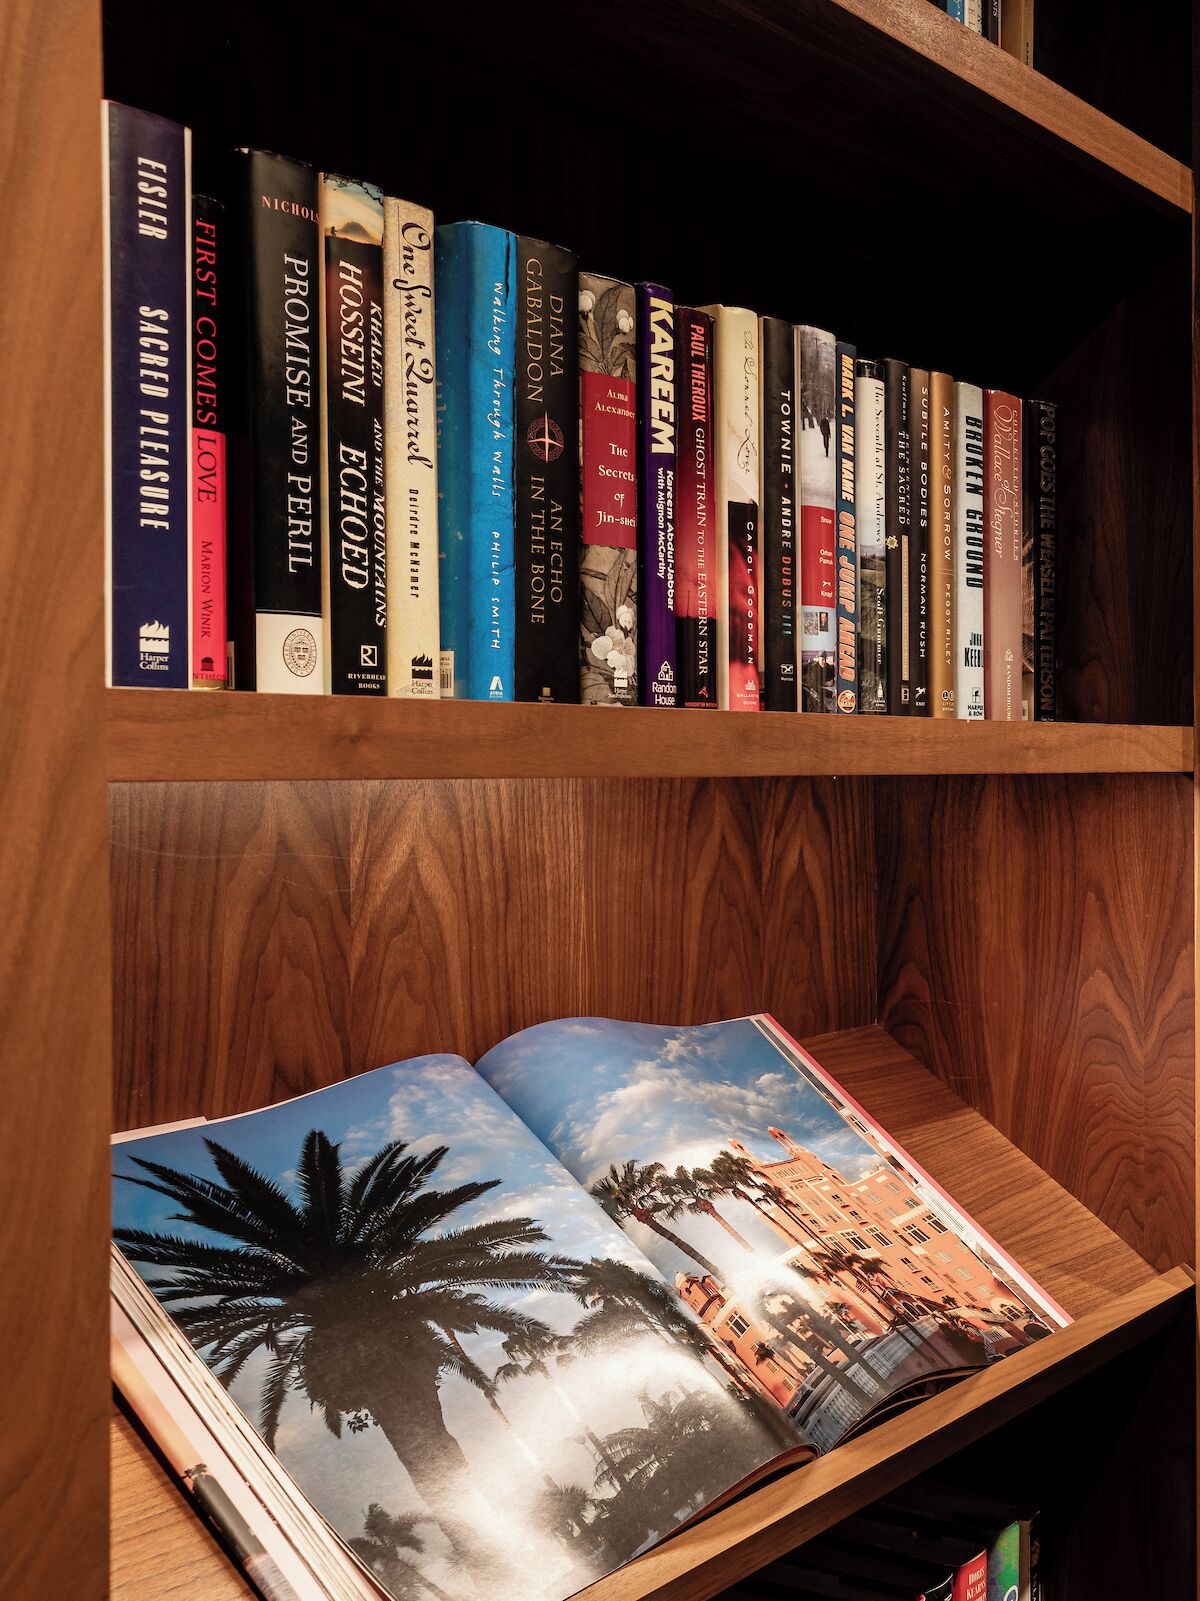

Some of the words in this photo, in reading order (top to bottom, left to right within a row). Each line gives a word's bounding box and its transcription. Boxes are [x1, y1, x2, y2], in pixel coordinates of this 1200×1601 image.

[138, 157, 167, 240] EISLER
[195, 220, 217, 305] FIRST
[401, 222, 432, 275] One
[284, 254, 310, 407] PROMISE
[339, 260, 365, 406] HOSSEINI
[393, 277, 432, 350] Sweet
[526, 258, 544, 403] GABALDON
[550, 294, 564, 377] DIANA
[139, 305, 169, 398] SACRED
[370, 301, 383, 387] KHALED
[691, 324, 705, 357] PAUL
[196, 317, 217, 425] COMES
[651, 296, 675, 454] KAREEM
[692, 361, 707, 422] THEROUX
[841, 353, 854, 402] MARK
[875, 386, 884, 405] The
[372, 418, 382, 451] AND
[403, 353, 434, 470] Quarrel
[780, 390, 791, 474] TOWNIE
[841, 406, 854, 418] L.
[875, 409, 884, 453] Seventh
[920, 387, 928, 451] SUBTLE
[292, 416, 308, 465] AND
[695, 428, 706, 479] GHOST
[841, 424, 855, 456] VAN
[898, 431, 906, 460] THE
[965, 416, 983, 496] BROKEN
[993, 405, 1013, 482] Wallace
[139, 409, 170, 530] PLEASURE
[197, 436, 217, 503] LOVE
[374, 455, 385, 487] THE
[531, 476, 545, 501] IN
[598, 465, 635, 482] Secrets
[842, 458, 855, 503] NAME
[1039, 445, 1056, 492] GOES
[339, 441, 369, 589] ECHOED
[409, 489, 419, 535] Deirdre
[550, 501, 563, 532] AN
[656, 489, 664, 529] Mignon
[666, 470, 675, 519] Kareem
[696, 483, 706, 526] TRAIN
[875, 492, 884, 542] Andrews
[898, 466, 906, 525] SACRED
[920, 461, 928, 528] BODIES
[1039, 497, 1056, 528] THE
[287, 472, 313, 573] PERIL
[531, 512, 545, 555] THE
[697, 530, 705, 543] TO
[746, 522, 754, 574] CAROL
[781, 497, 791, 548] ANDRE
[839, 512, 856, 552] ONE
[991, 488, 1013, 558] Stegner
[201, 541, 213, 594] MARION
[372, 490, 387, 627] MOUNTAINS
[409, 542, 420, 598] McNamer
[491, 531, 501, 586] PHILIP
[550, 541, 563, 603] ECHO
[657, 530, 665, 579] McCarthy
[666, 522, 675, 611] Abdul-Jabbar
[697, 547, 705, 569] THE
[966, 509, 983, 589] GROUND
[1039, 533, 1056, 596] WEASEL
[531, 566, 545, 625] BONE
[697, 573, 707, 632] EASTERN
[781, 556, 791, 607] DUBUS
[839, 555, 855, 614] JUMP
[876, 588, 885, 616] Scott
[201, 599, 214, 638] WINIK
[491, 598, 501, 649] SMITH
[781, 615, 792, 636] III
[876, 618, 885, 664] Gummer
[139, 652, 169, 663] Harper
[139, 661, 169, 671] Collins
[698, 636, 708, 675] STAR
[839, 617, 856, 682] AHEAD
[1039, 610, 1056, 711] PATTERSON
[347, 672, 386, 681] RIVERHEAD
[358, 682, 380, 690] BOOKS
[652, 682, 677, 693] Random
[655, 694, 675, 706] House
[968, 1568, 985, 1585] DORIS
